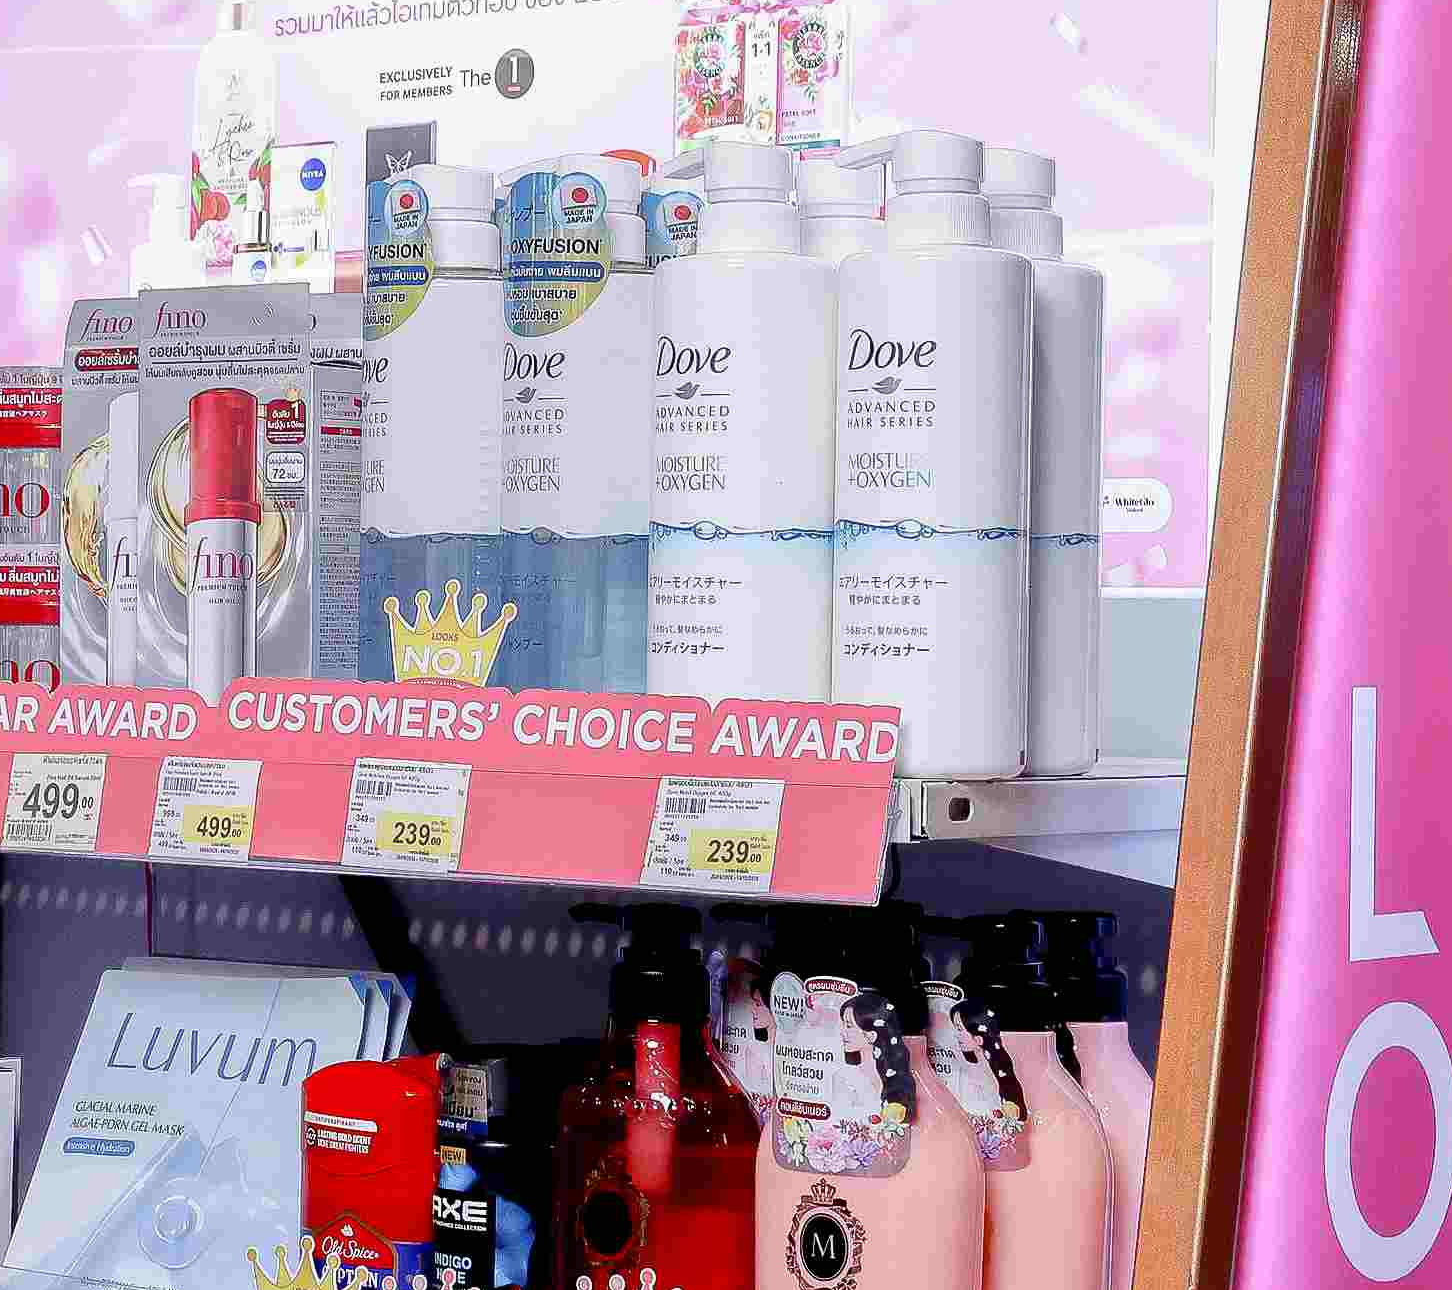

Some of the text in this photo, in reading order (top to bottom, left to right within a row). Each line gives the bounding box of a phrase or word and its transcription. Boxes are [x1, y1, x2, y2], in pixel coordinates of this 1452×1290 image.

[378, 65, 454, 86] EXCLUSIVELY
[380, 83, 454, 103] FOR MEMBERS
[458, 66, 492, 89] The
[151, 300, 209, 342] fino
[845, 327, 938, 372] Dove
[845, 397, 937, 416] ADVANCED
[47, 696, 199, 743] AWARD
[512, 704, 696, 755] CHOICE
[708, 713, 900, 765] AWARD
[105, 1011, 320, 1089] Luvum
